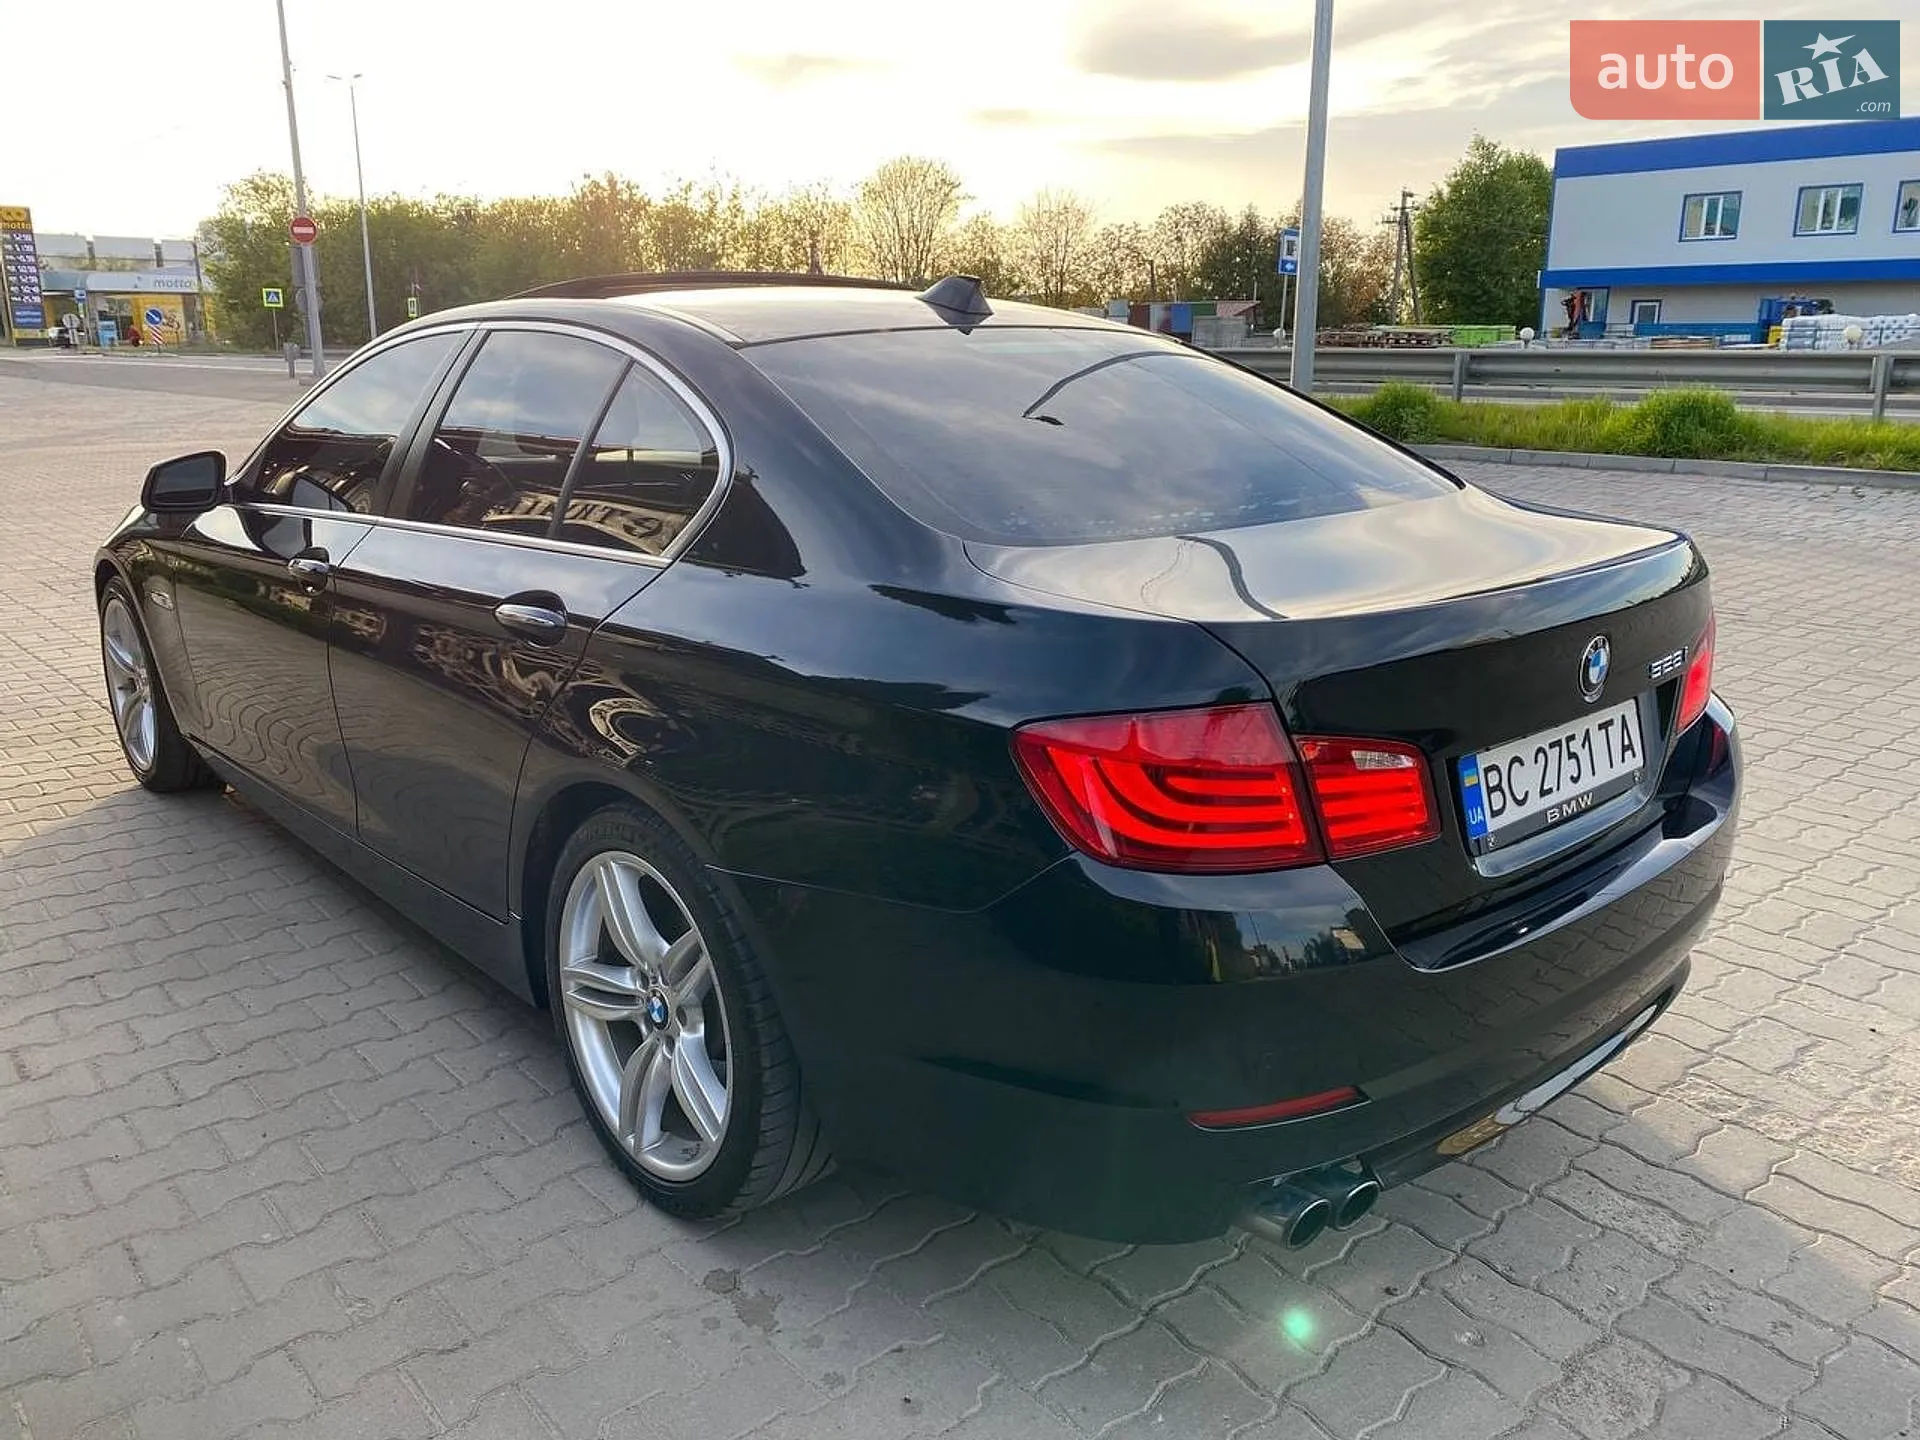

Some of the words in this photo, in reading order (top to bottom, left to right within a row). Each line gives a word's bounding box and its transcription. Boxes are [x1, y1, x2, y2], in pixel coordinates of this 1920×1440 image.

[1483, 755, 1529, 819] BC
[1533, 728, 1596, 797] 2751
[1597, 714, 1636, 769] TA
[1468, 807, 1485, 825] UA
[1546, 792, 1594, 823] BMW
